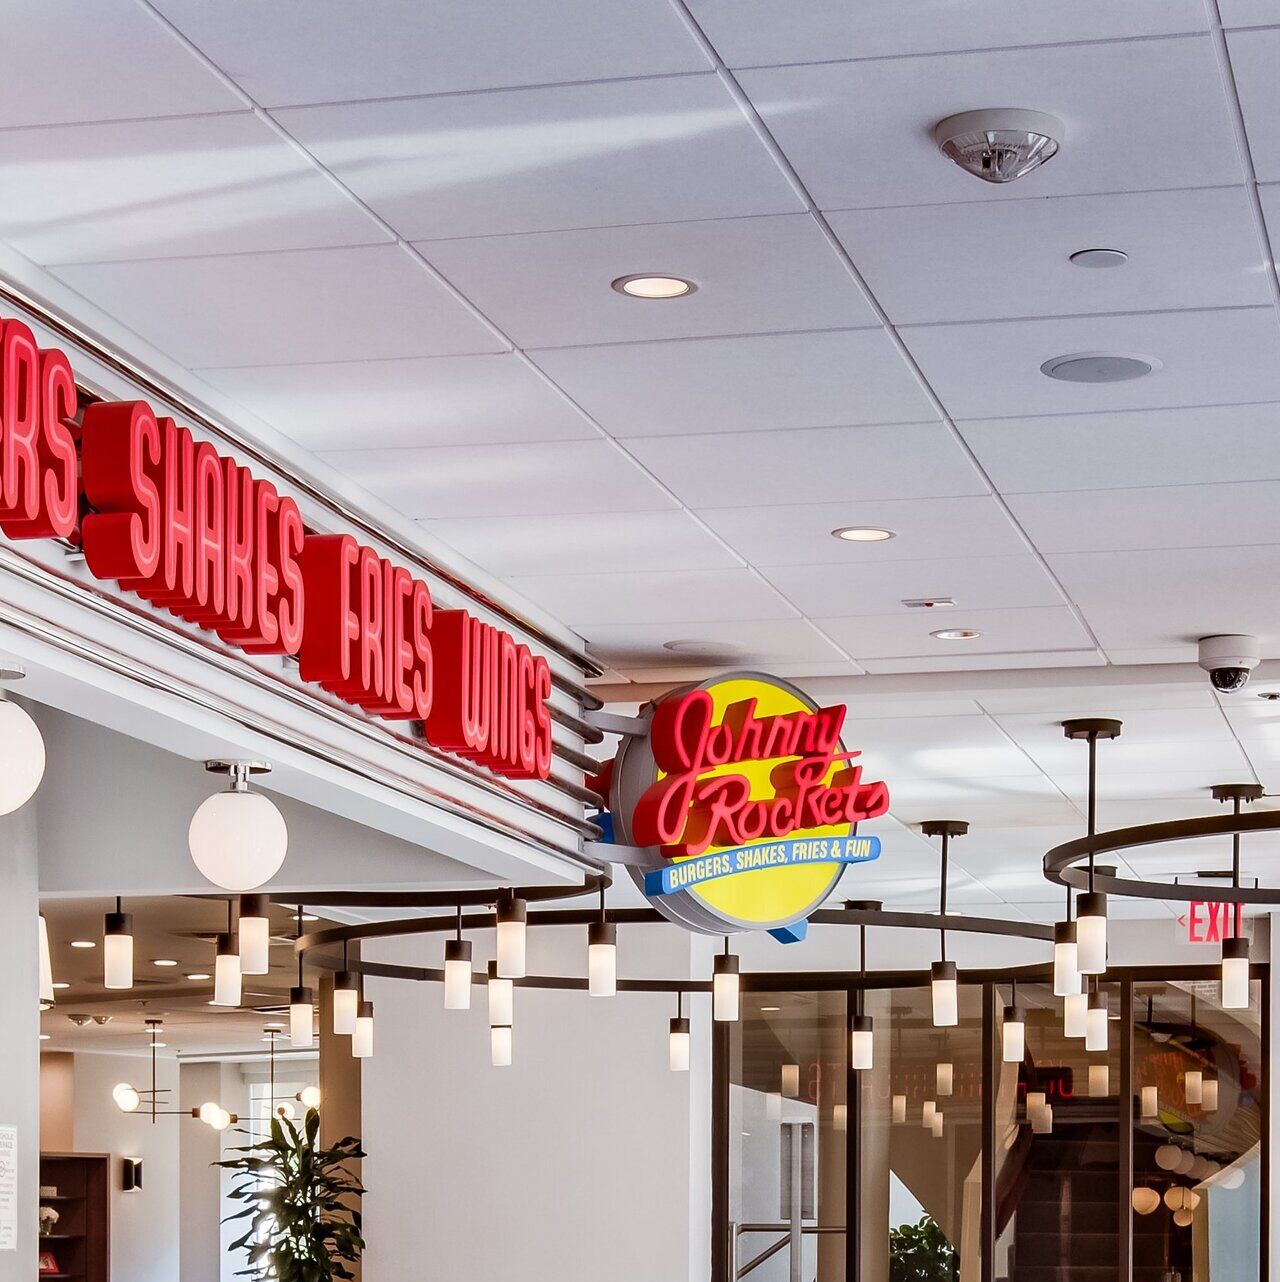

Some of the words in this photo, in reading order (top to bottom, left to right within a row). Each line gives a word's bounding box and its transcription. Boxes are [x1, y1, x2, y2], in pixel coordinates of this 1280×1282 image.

[125, 400, 305, 655] SHAKES
[332, 533, 434, 720] FRIES
[656, 690, 862, 843] Johnny
[686, 761, 890, 856] Rockets
[670, 858, 733, 889] BURGERS,
[736, 845, 788, 870] SHAKES,
[792, 841, 828, 861] FRIES
[831, 840, 841, 858] &
[845, 840, 871, 858] FUN
[1189, 900, 1245, 942] EXIT
